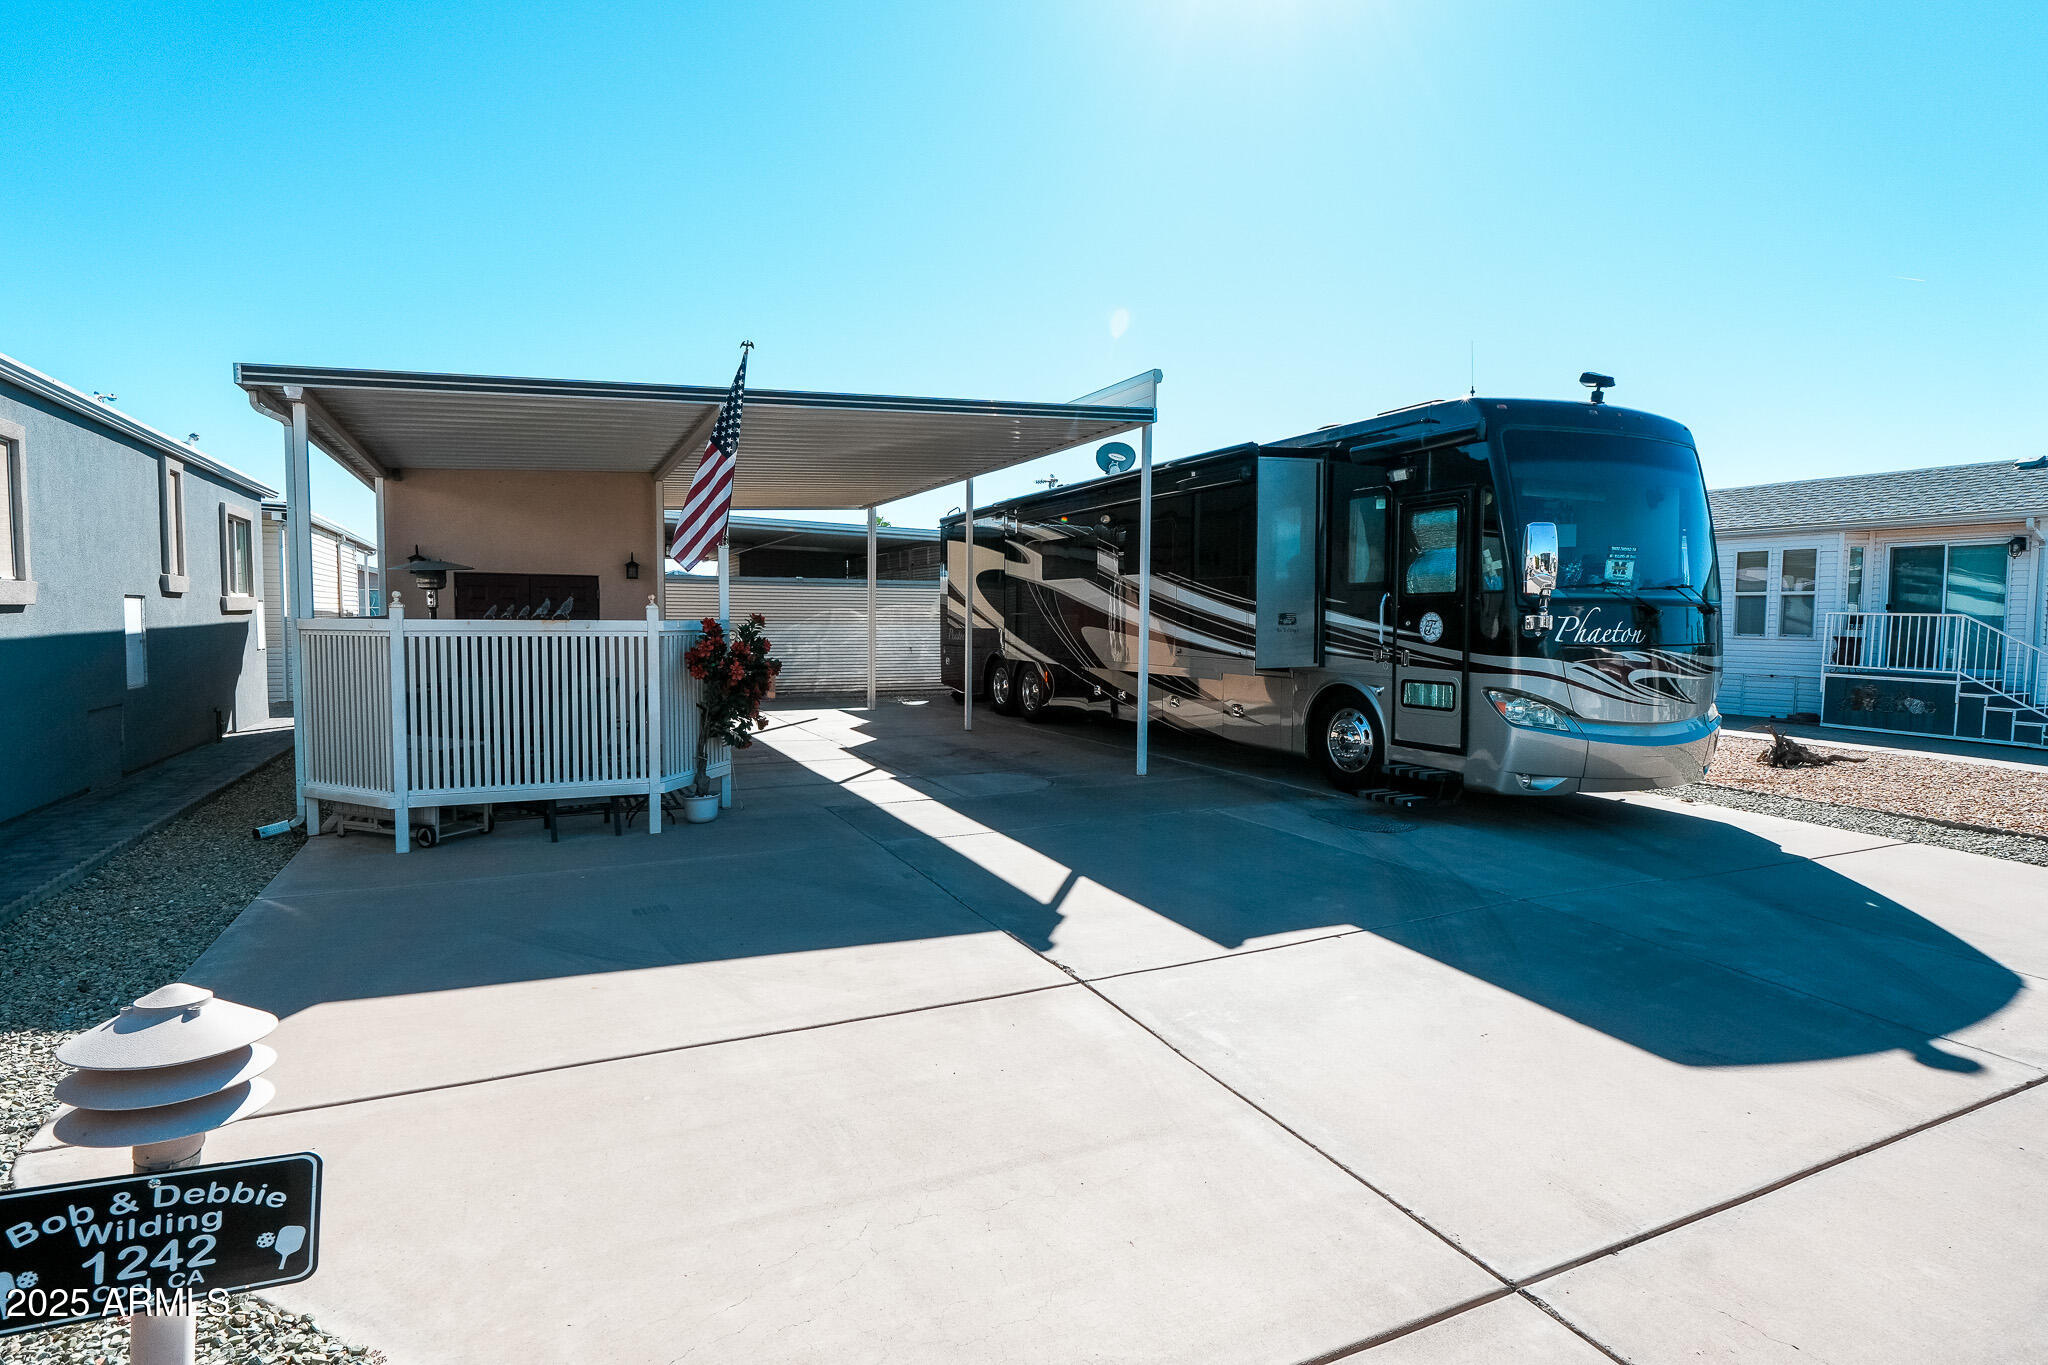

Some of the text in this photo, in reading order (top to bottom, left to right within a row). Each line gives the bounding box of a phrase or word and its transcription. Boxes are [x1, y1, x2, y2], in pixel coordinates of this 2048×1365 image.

[1555, 606, 1646, 644] Phaeton
[5, 1181, 287, 1249] Bob & Debbie
[74, 1210, 223, 1247] Wilding
[81, 1234, 217, 1285] 1242
[168, 1269, 205, 1288] CA
